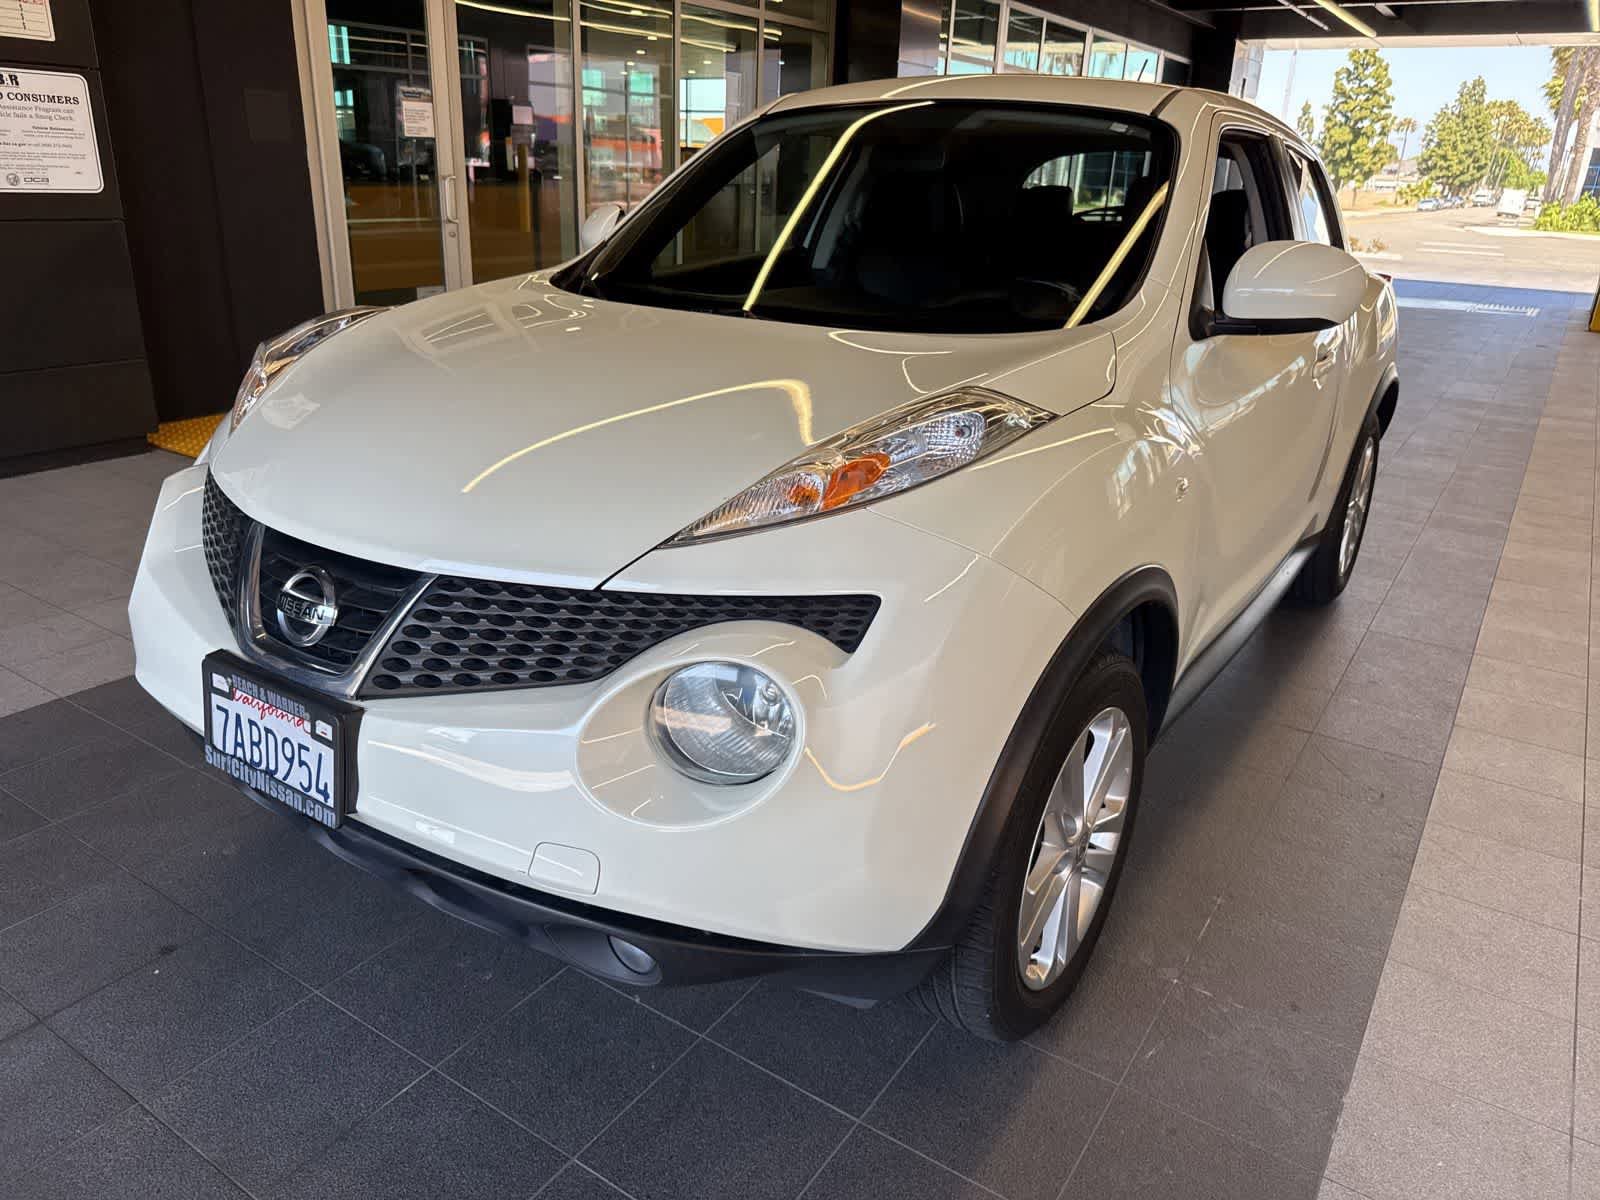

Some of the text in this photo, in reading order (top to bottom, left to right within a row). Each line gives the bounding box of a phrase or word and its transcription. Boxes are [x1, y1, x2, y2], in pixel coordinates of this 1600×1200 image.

[7, 91, 80, 106] CONSUMERS
[34, 105, 62, 114] Program
[280, 592, 326, 621] NISSAN
[232, 674, 258, 698] BEACH
[267, 690, 306, 717] WARNER
[215, 703, 331, 804] 7ABD954
[205, 743, 337, 829] SurfCityNissan.com
